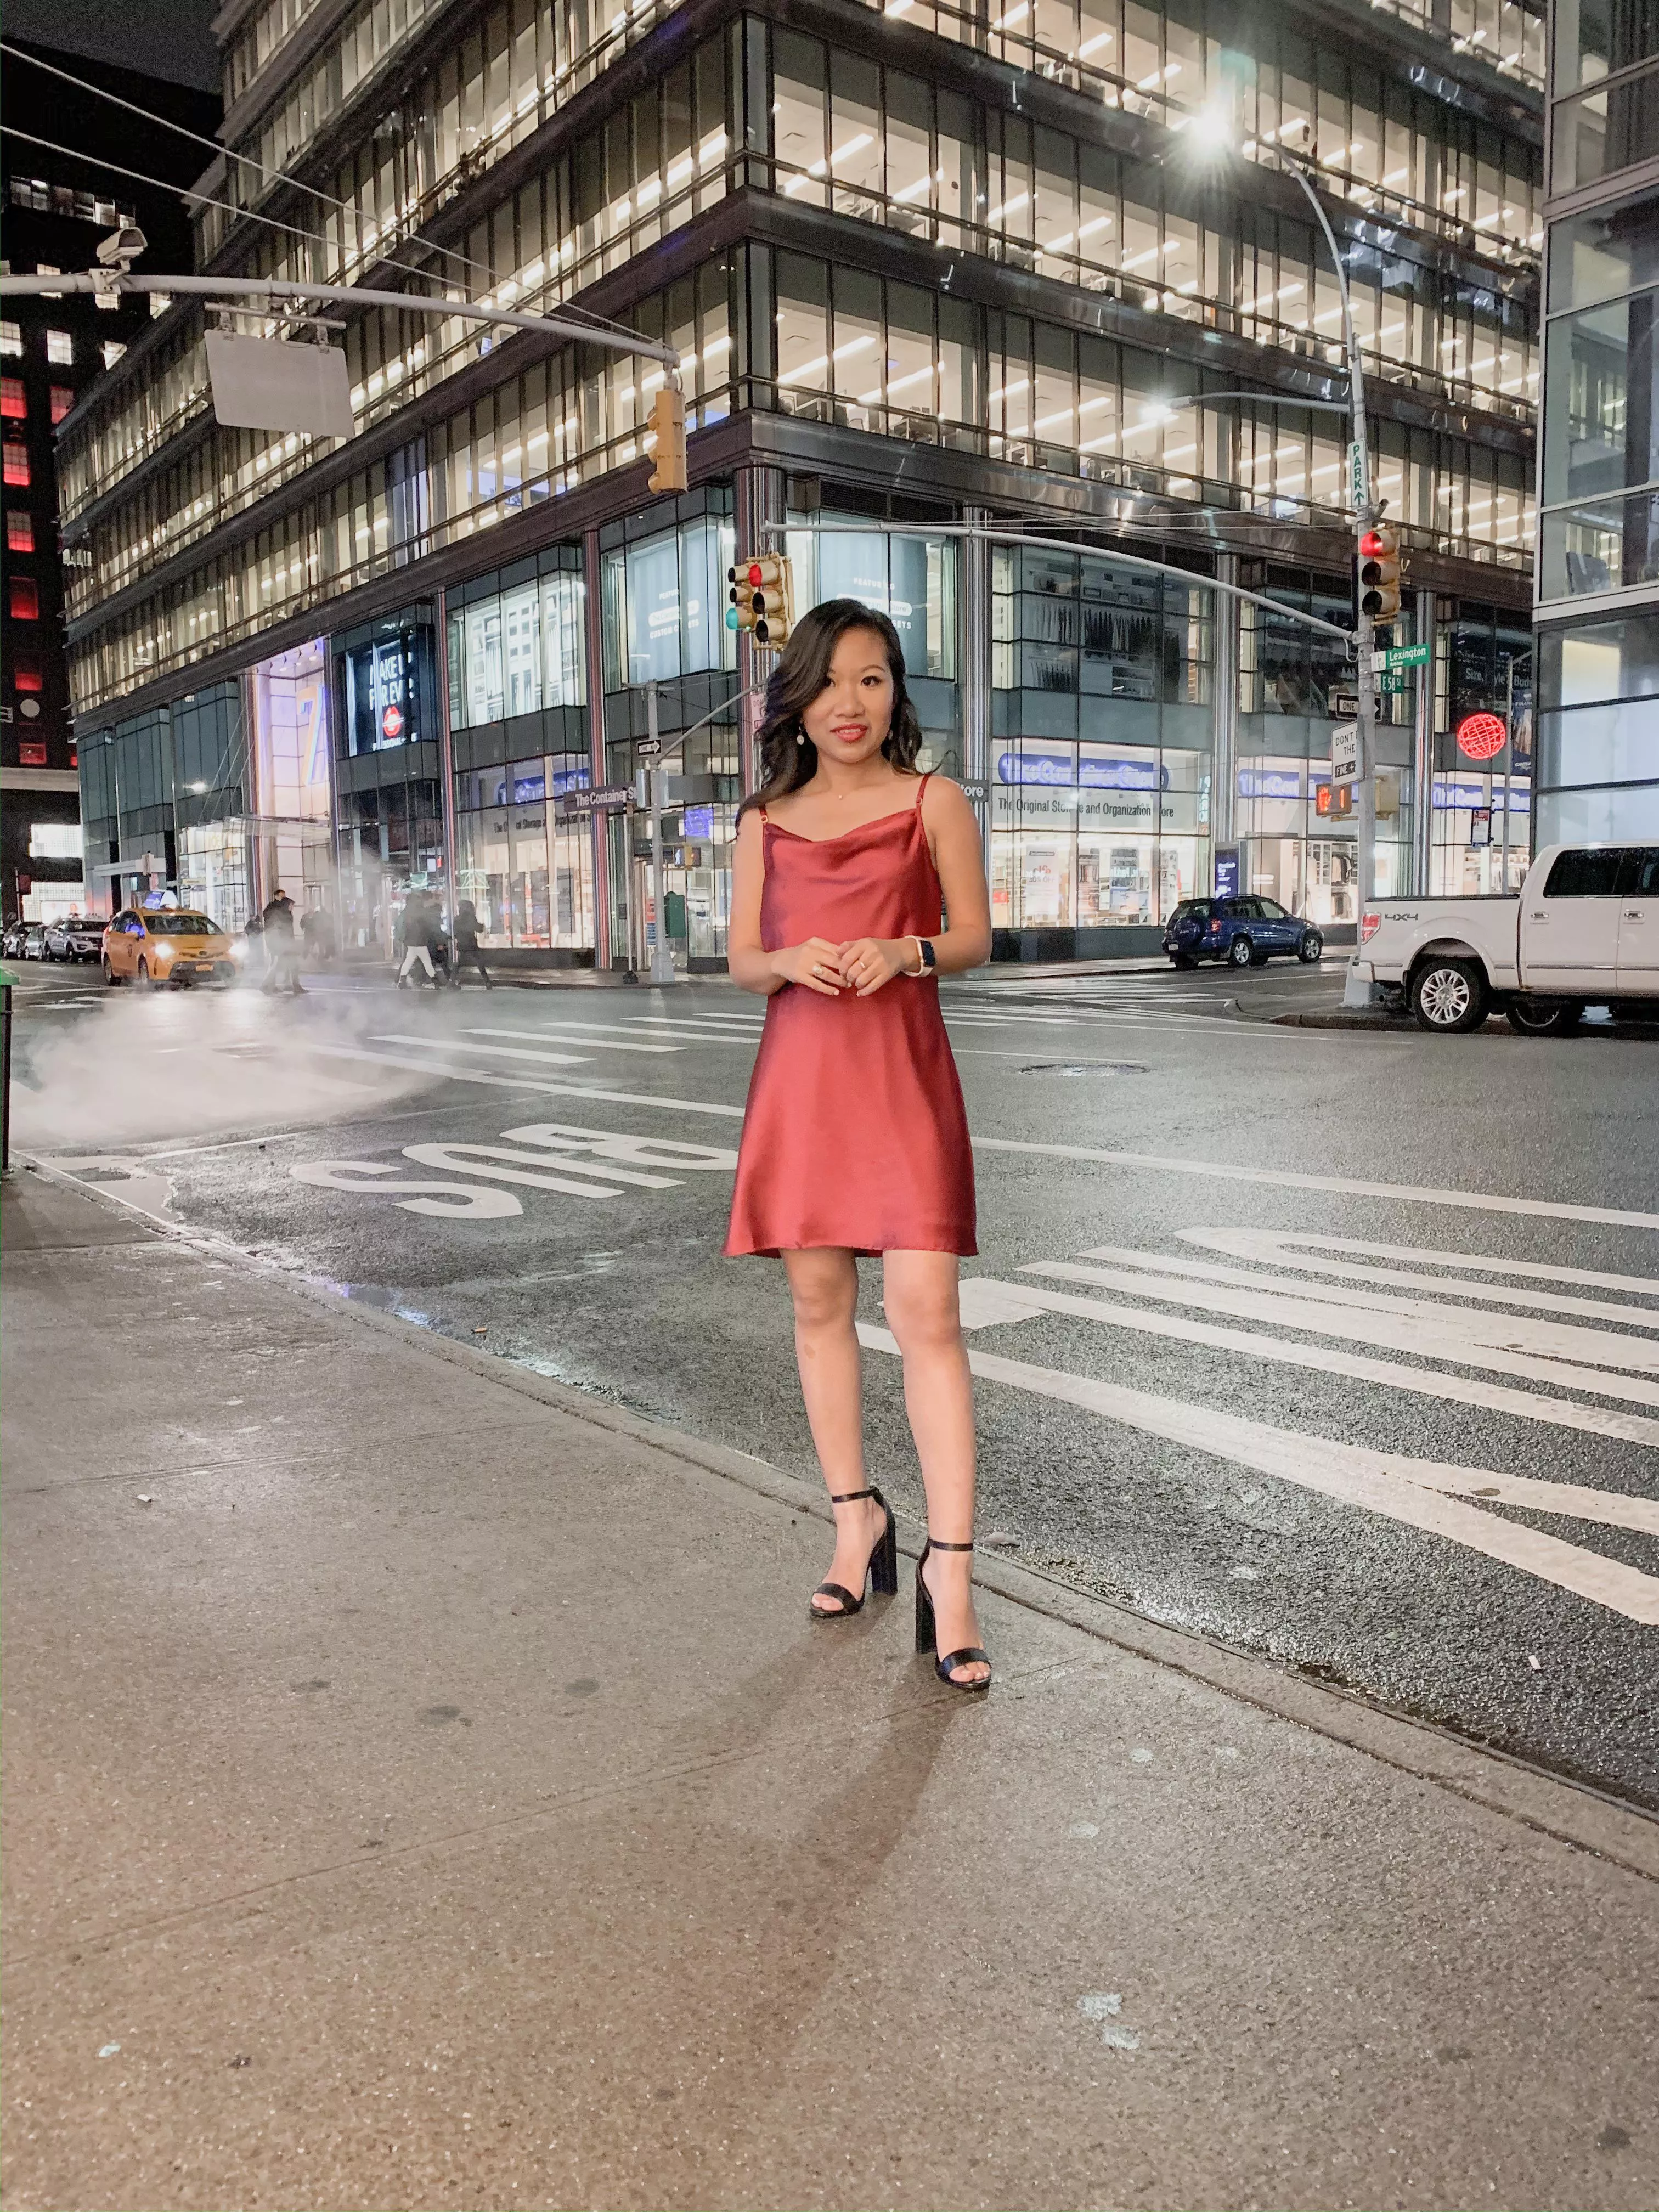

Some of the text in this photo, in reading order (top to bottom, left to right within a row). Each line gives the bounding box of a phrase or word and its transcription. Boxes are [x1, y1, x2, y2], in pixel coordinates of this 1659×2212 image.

[1353, 444, 1363, 491] PARK
[853, 577, 895, 591] FEATURG
[650, 626, 673, 639] CUSTOM
[1389, 647, 1426, 662] Lexington
[1383, 676, 1387, 690] E
[1387, 676, 1396, 691] 58
[1342, 702, 1355, 712] ONE
[1343, 744, 1356, 756] THE
[1336, 764, 1348, 776] FINE
[575, 793, 590, 808] The
[590, 788, 627, 805] Container
[998, 797, 1013, 811] The
[1016, 798, 1049, 814] Original
[1086, 803, 1101, 814] and
[1103, 803, 1151, 817] Organization
